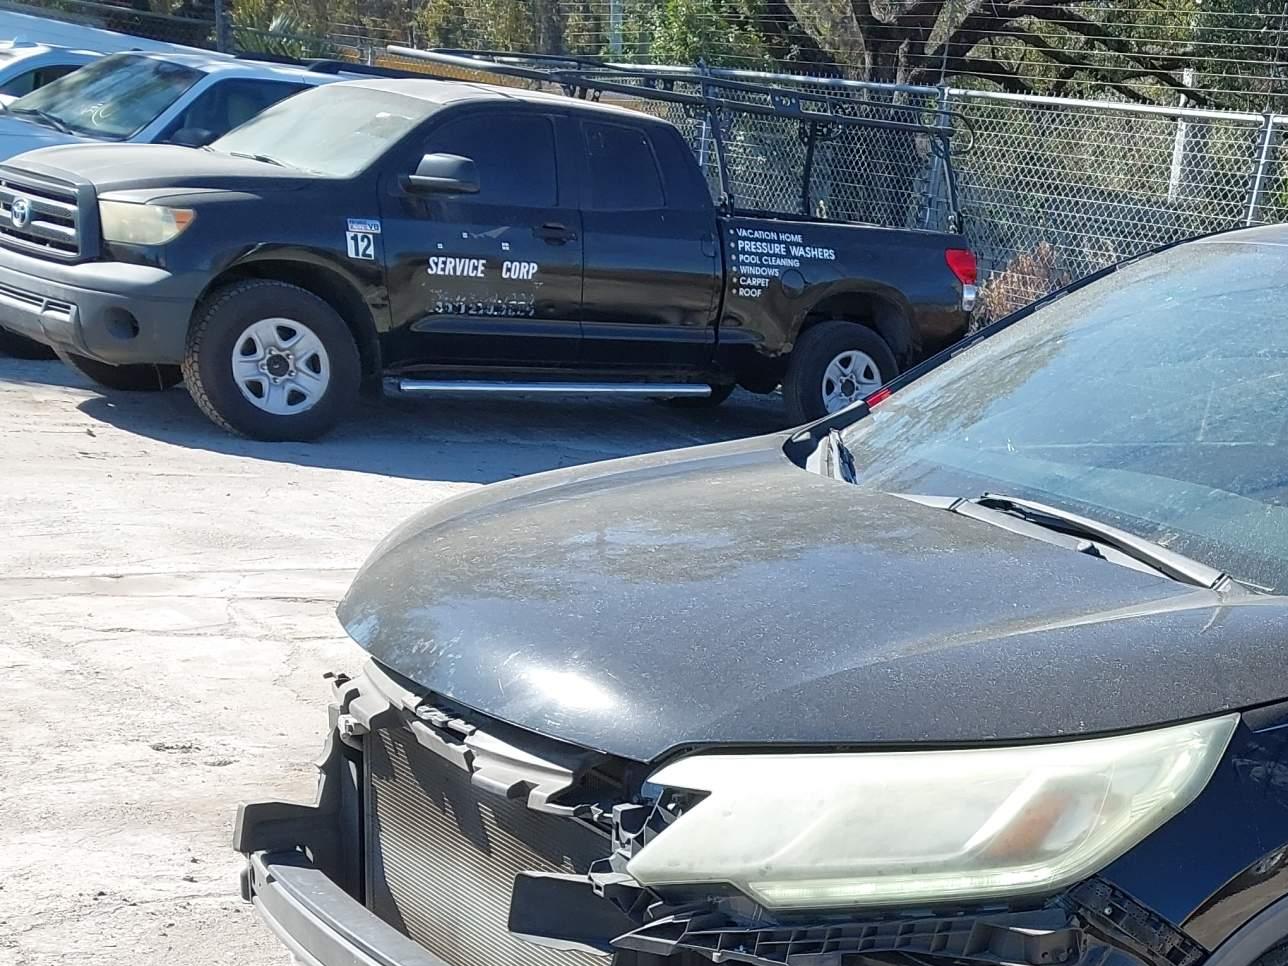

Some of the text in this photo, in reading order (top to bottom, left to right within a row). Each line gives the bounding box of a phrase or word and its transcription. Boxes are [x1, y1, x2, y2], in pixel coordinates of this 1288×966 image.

[736, 228, 802, 243] VACATION HOME
[350, 233, 373, 259] 12
[738, 240, 836, 260] PRESSURE WASHERS
[739, 254, 800, 267] POOL CLEANING
[427, 256, 538, 280] SERVICE CORP
[739, 265, 780, 277] WINDOWS
[739, 276, 770, 288] CARPET
[738, 288, 762, 298] ROOF
